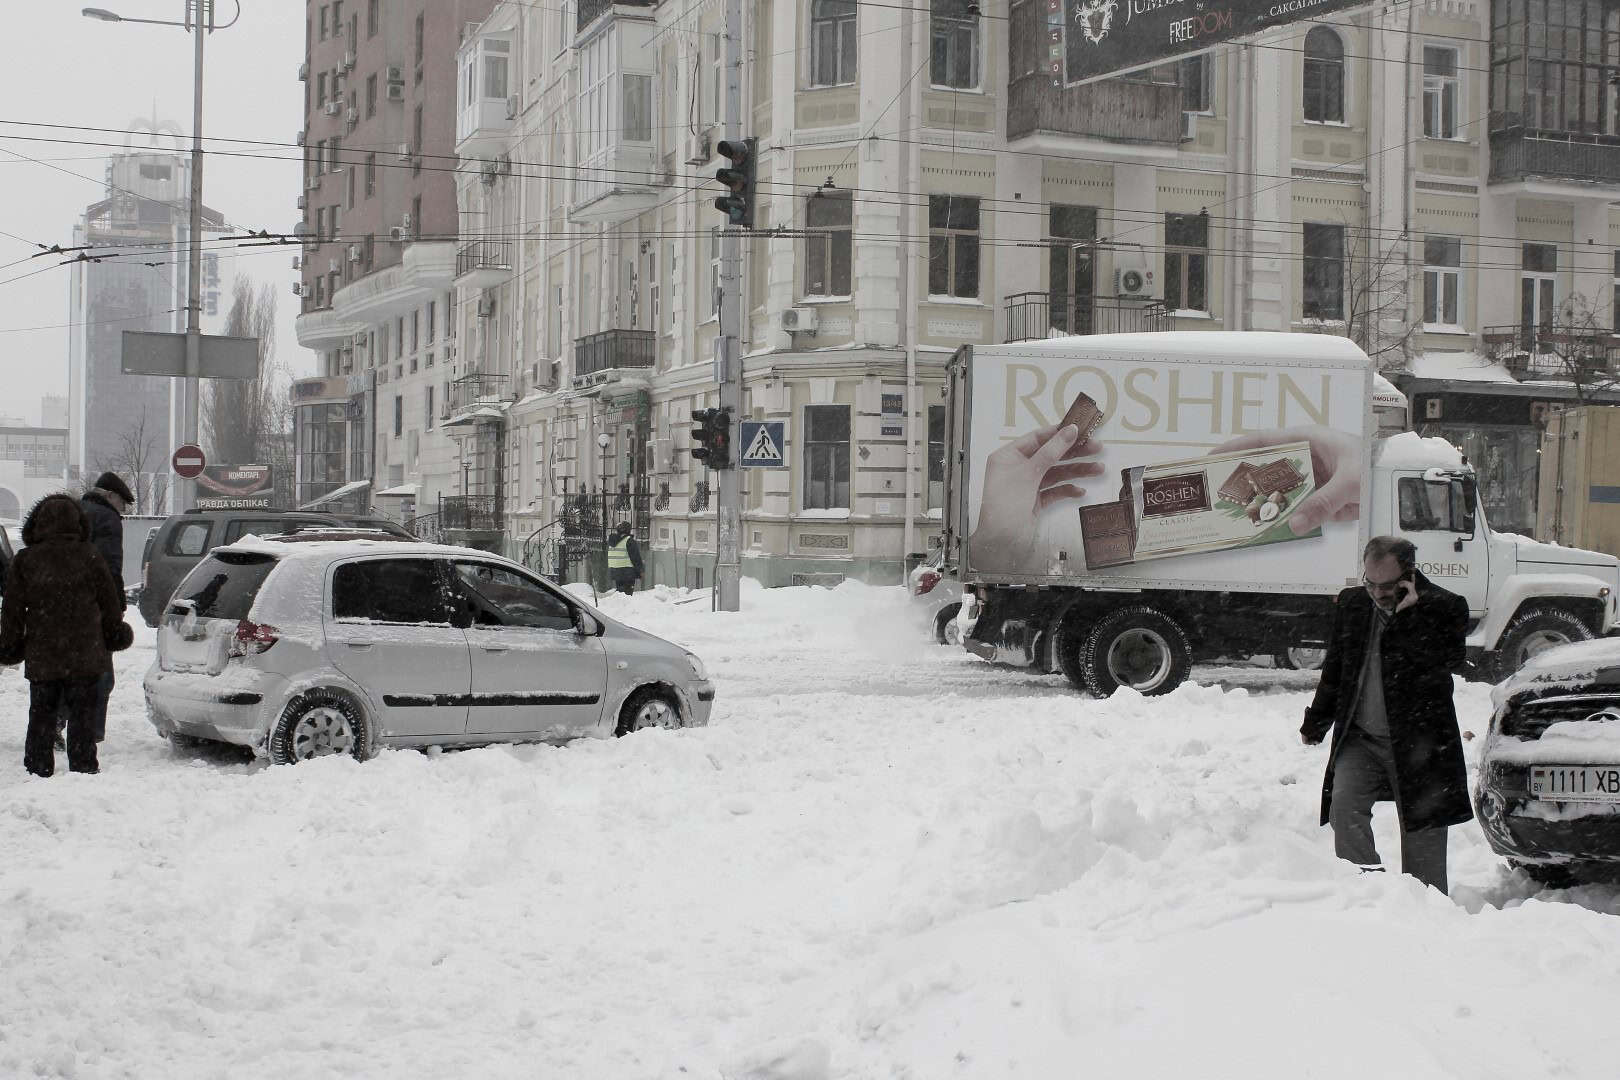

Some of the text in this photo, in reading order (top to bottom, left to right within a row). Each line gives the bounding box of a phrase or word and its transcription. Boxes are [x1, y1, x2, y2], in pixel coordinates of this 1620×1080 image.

[1169, 8, 1233, 44] FREEDOM
[1002, 363, 1332, 434] ROSHEN
[230, 499, 269, 508] ОБПІКАЄ
[1146, 486, 1200, 505] ROSHEN
[1533, 782, 1543, 792] BY
[1549, 769, 1620, 793] 1111 XB
